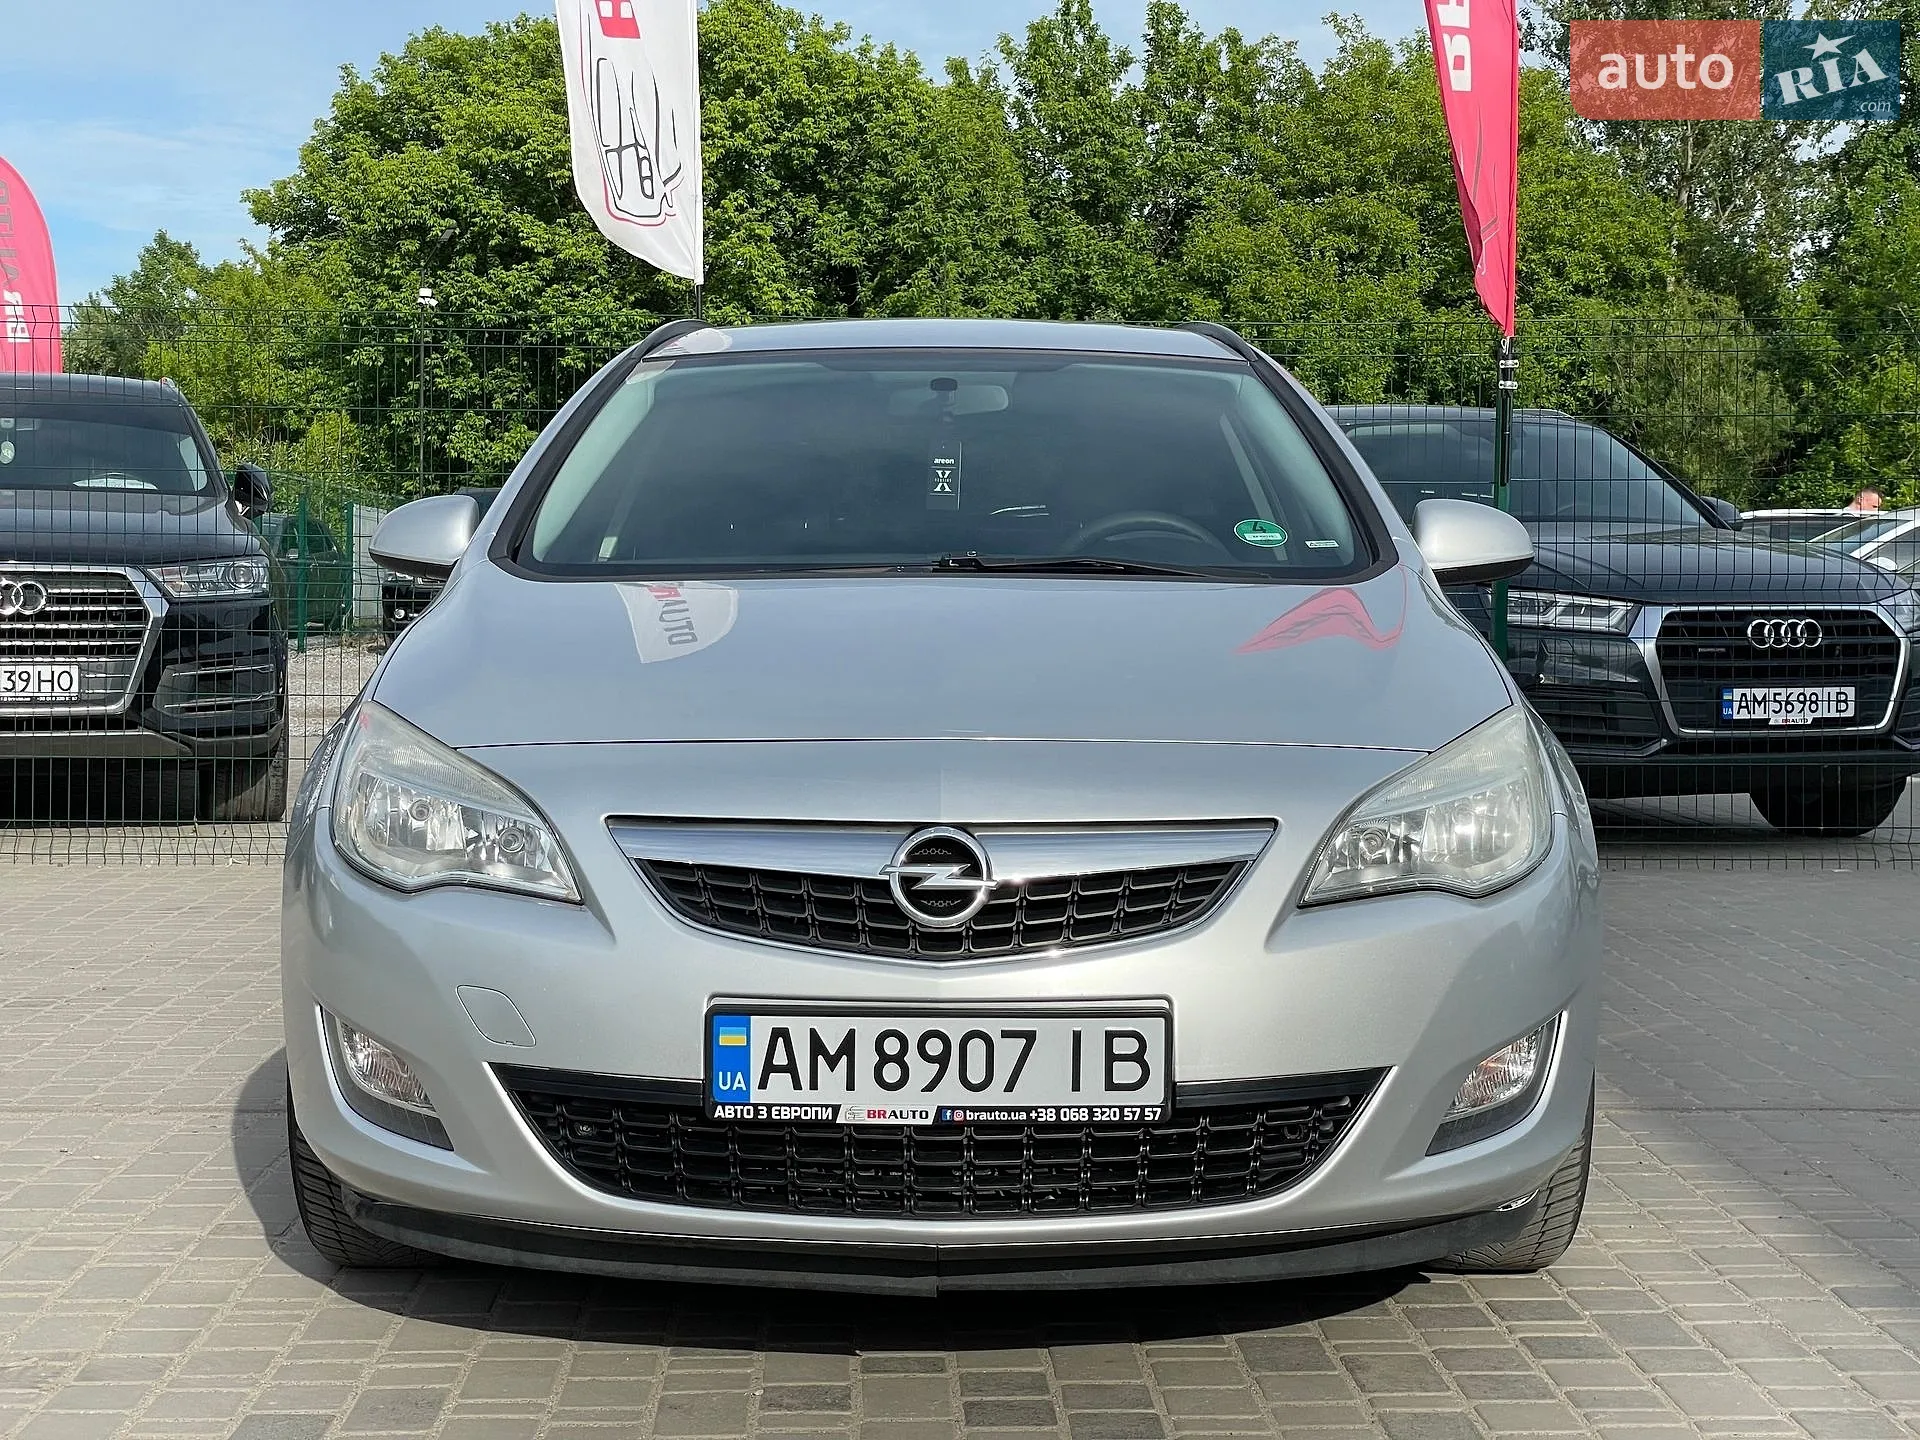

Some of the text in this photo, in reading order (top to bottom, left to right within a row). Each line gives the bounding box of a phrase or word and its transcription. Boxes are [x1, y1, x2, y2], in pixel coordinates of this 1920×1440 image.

[718, 1071, 747, 1092] UA
[713, 1105, 754, 1119] АВТО
[771, 1106, 833, 1120] ЄВРОПИ
[866, 1109, 930, 1120] BRAUTO
[965, 1107, 1162, 1121] brauto.ua +38 068 320 57 57
